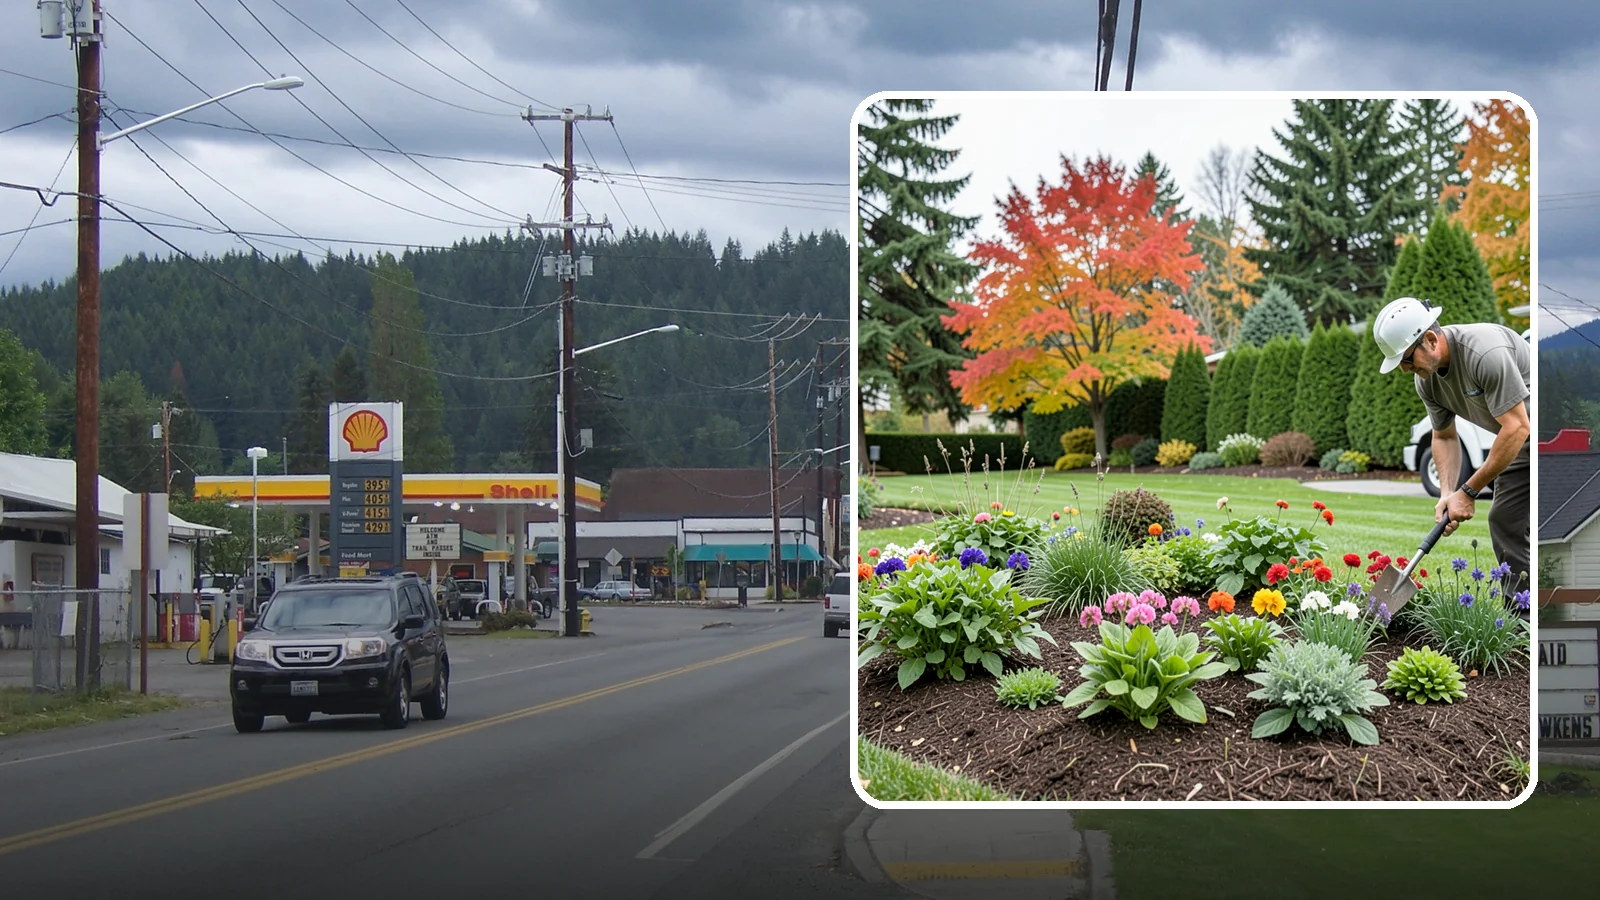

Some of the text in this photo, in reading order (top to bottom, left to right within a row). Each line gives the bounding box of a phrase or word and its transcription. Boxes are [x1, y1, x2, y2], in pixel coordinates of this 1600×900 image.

[366, 480, 383, 490] 395
[490, 484, 547, 499] Shell
[366, 494, 383, 504] 405
[365, 508, 383, 518] 415
[366, 522, 383, 533] 429
